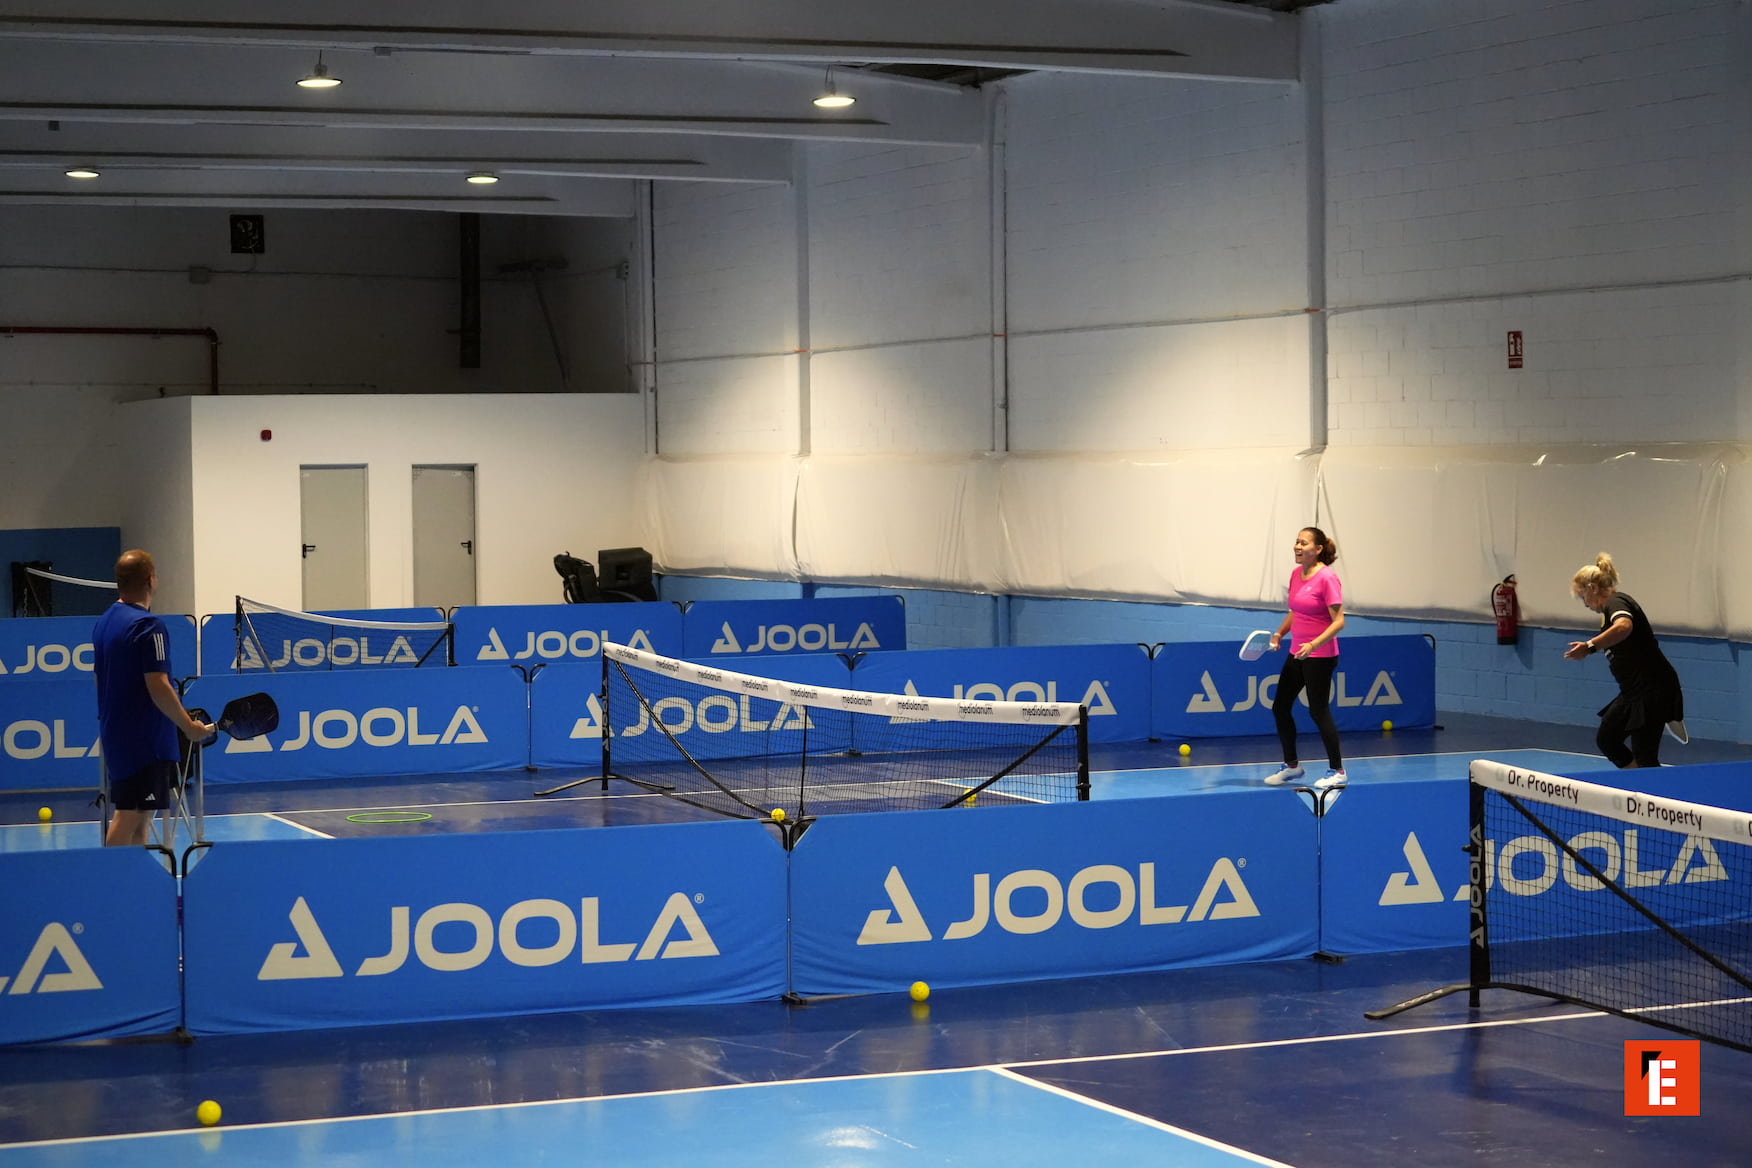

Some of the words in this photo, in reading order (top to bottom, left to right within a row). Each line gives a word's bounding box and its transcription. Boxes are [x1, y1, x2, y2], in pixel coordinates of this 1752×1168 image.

[271, 635, 420, 668] JOOLA
[747, 622, 881, 652] JOOLA
[13, 643, 95, 674] JOO
[622, 694, 815, 738] JOOLA
[959, 703, 994, 716] mediolanum
[1021, 706, 1061, 718] mediolanum
[279, 704, 488, 752] JOOLA
[1507, 769, 1525, 789] Dr.
[1527, 773, 1579, 803] Property
[1626, 796, 1645, 817] Dr.
[1647, 801, 1703, 831] Property
[942, 856, 1262, 940] JOOLA
[355, 891, 721, 977] JOOLA
